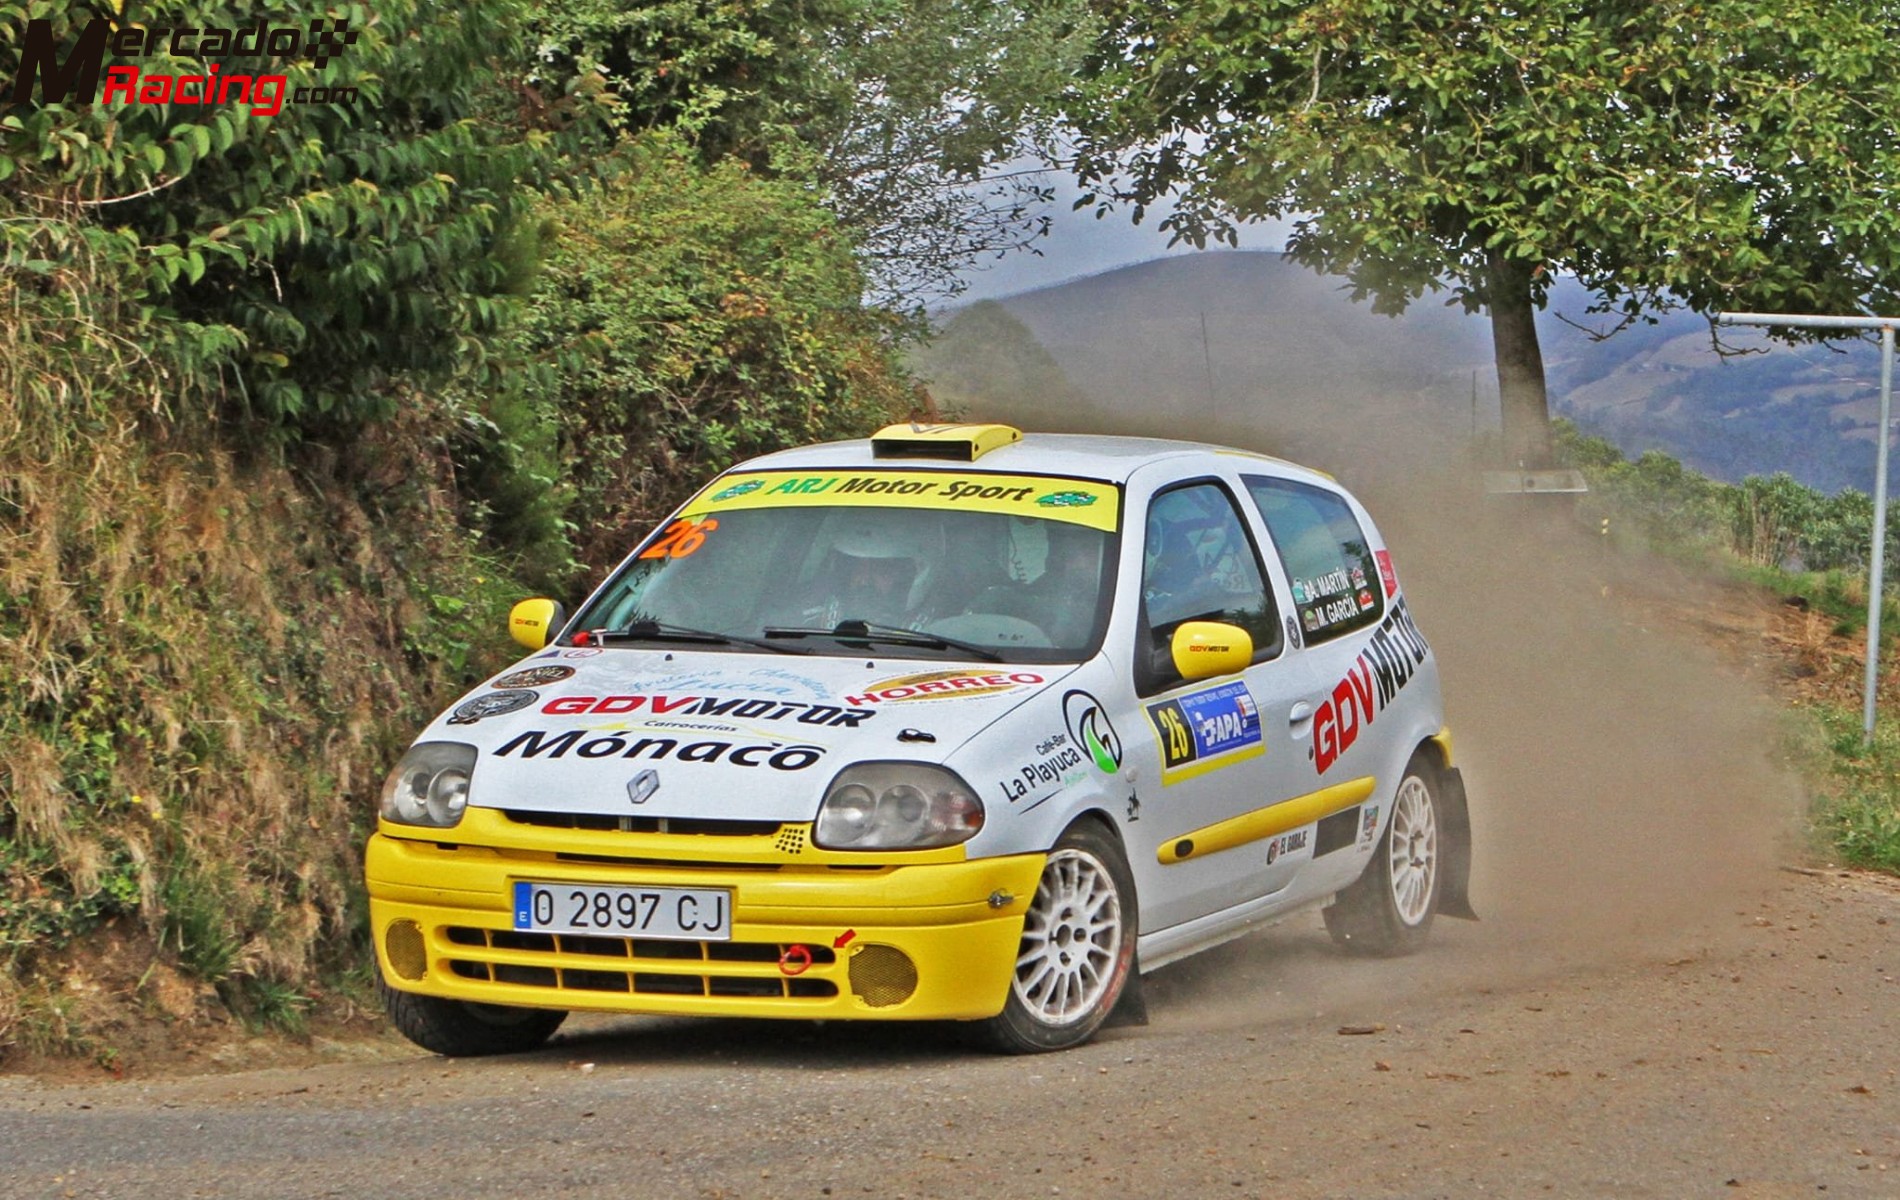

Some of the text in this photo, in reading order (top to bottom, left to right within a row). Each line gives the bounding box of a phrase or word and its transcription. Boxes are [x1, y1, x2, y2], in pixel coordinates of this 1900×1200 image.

[764, 478, 1033, 500] ARJ Motor Sport
[639, 518, 719, 559] 26
[1326, 593, 1359, 623] GARCÍA
[845, 673, 1045, 706] HORREO
[493, 729, 827, 771] Mónaco
[1158, 707, 1189, 760] 26
[999, 778, 1029, 803] La
[1020, 746, 1082, 789] Playuca
[518, 911, 527, 922] E
[569, 890, 661, 930] 2897
[677, 894, 723, 932] CJ
